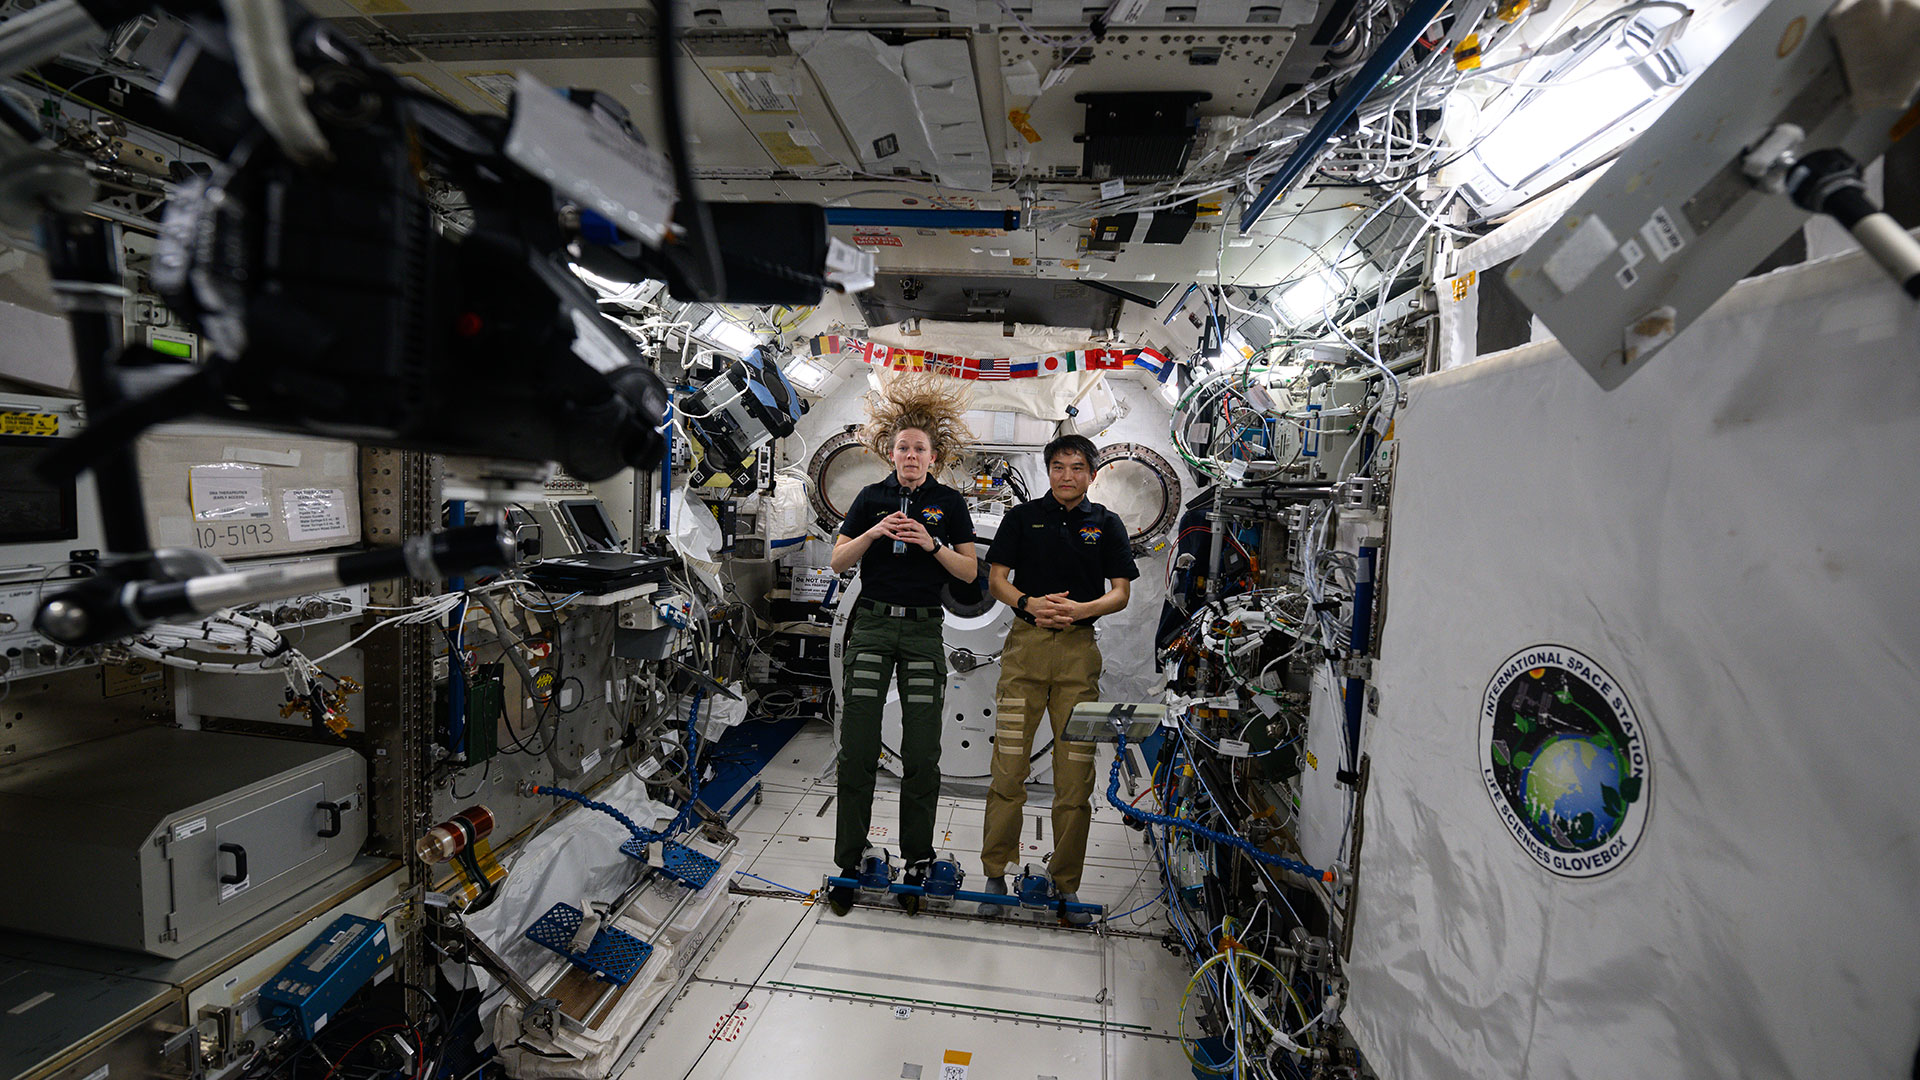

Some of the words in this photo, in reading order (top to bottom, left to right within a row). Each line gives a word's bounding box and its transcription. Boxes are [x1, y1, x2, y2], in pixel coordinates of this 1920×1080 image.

[196, 523, 274, 549] 1.0-5193
[1486, 652, 1563, 718] INTERNATIONAL
[1567, 656, 1612, 696] SPACE
[1612, 696, 1645, 779] STATION
[1484, 768, 1502, 804] LIFE
[1500, 804, 1551, 864] SCIENCES
[1553, 835, 1629, 871] GLOVEBOX
